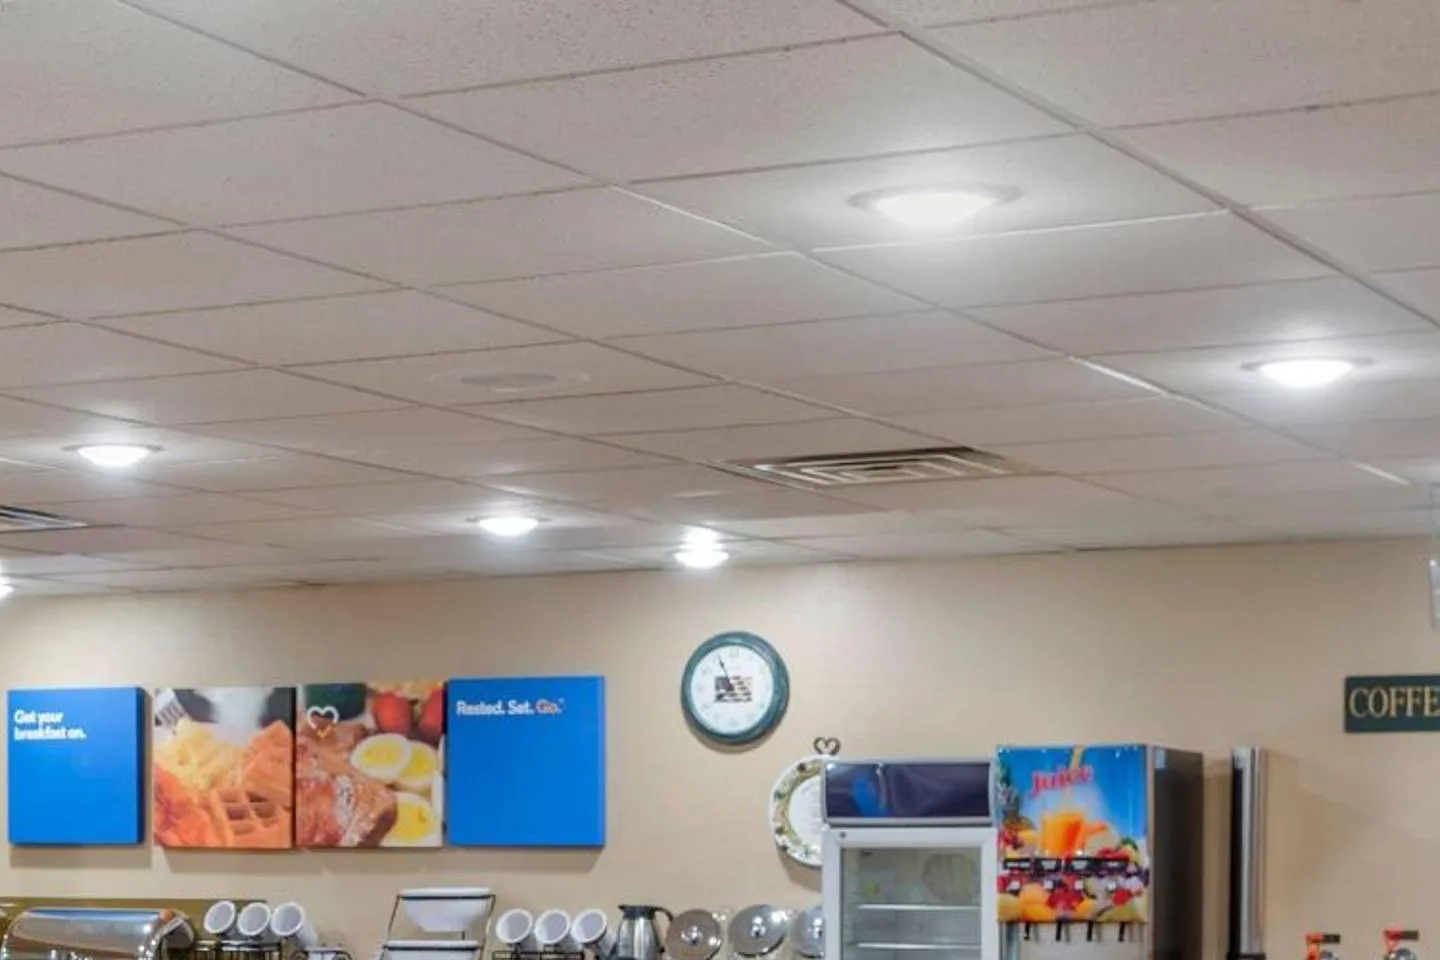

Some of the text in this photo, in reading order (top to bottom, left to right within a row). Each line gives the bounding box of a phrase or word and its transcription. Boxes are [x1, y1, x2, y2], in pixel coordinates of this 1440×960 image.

[456, 699, 505, 716] Rested.
[507, 699, 535, 716] Set.
[14, 709, 64, 730] Get your
[14, 726, 66, 740] breakfast
